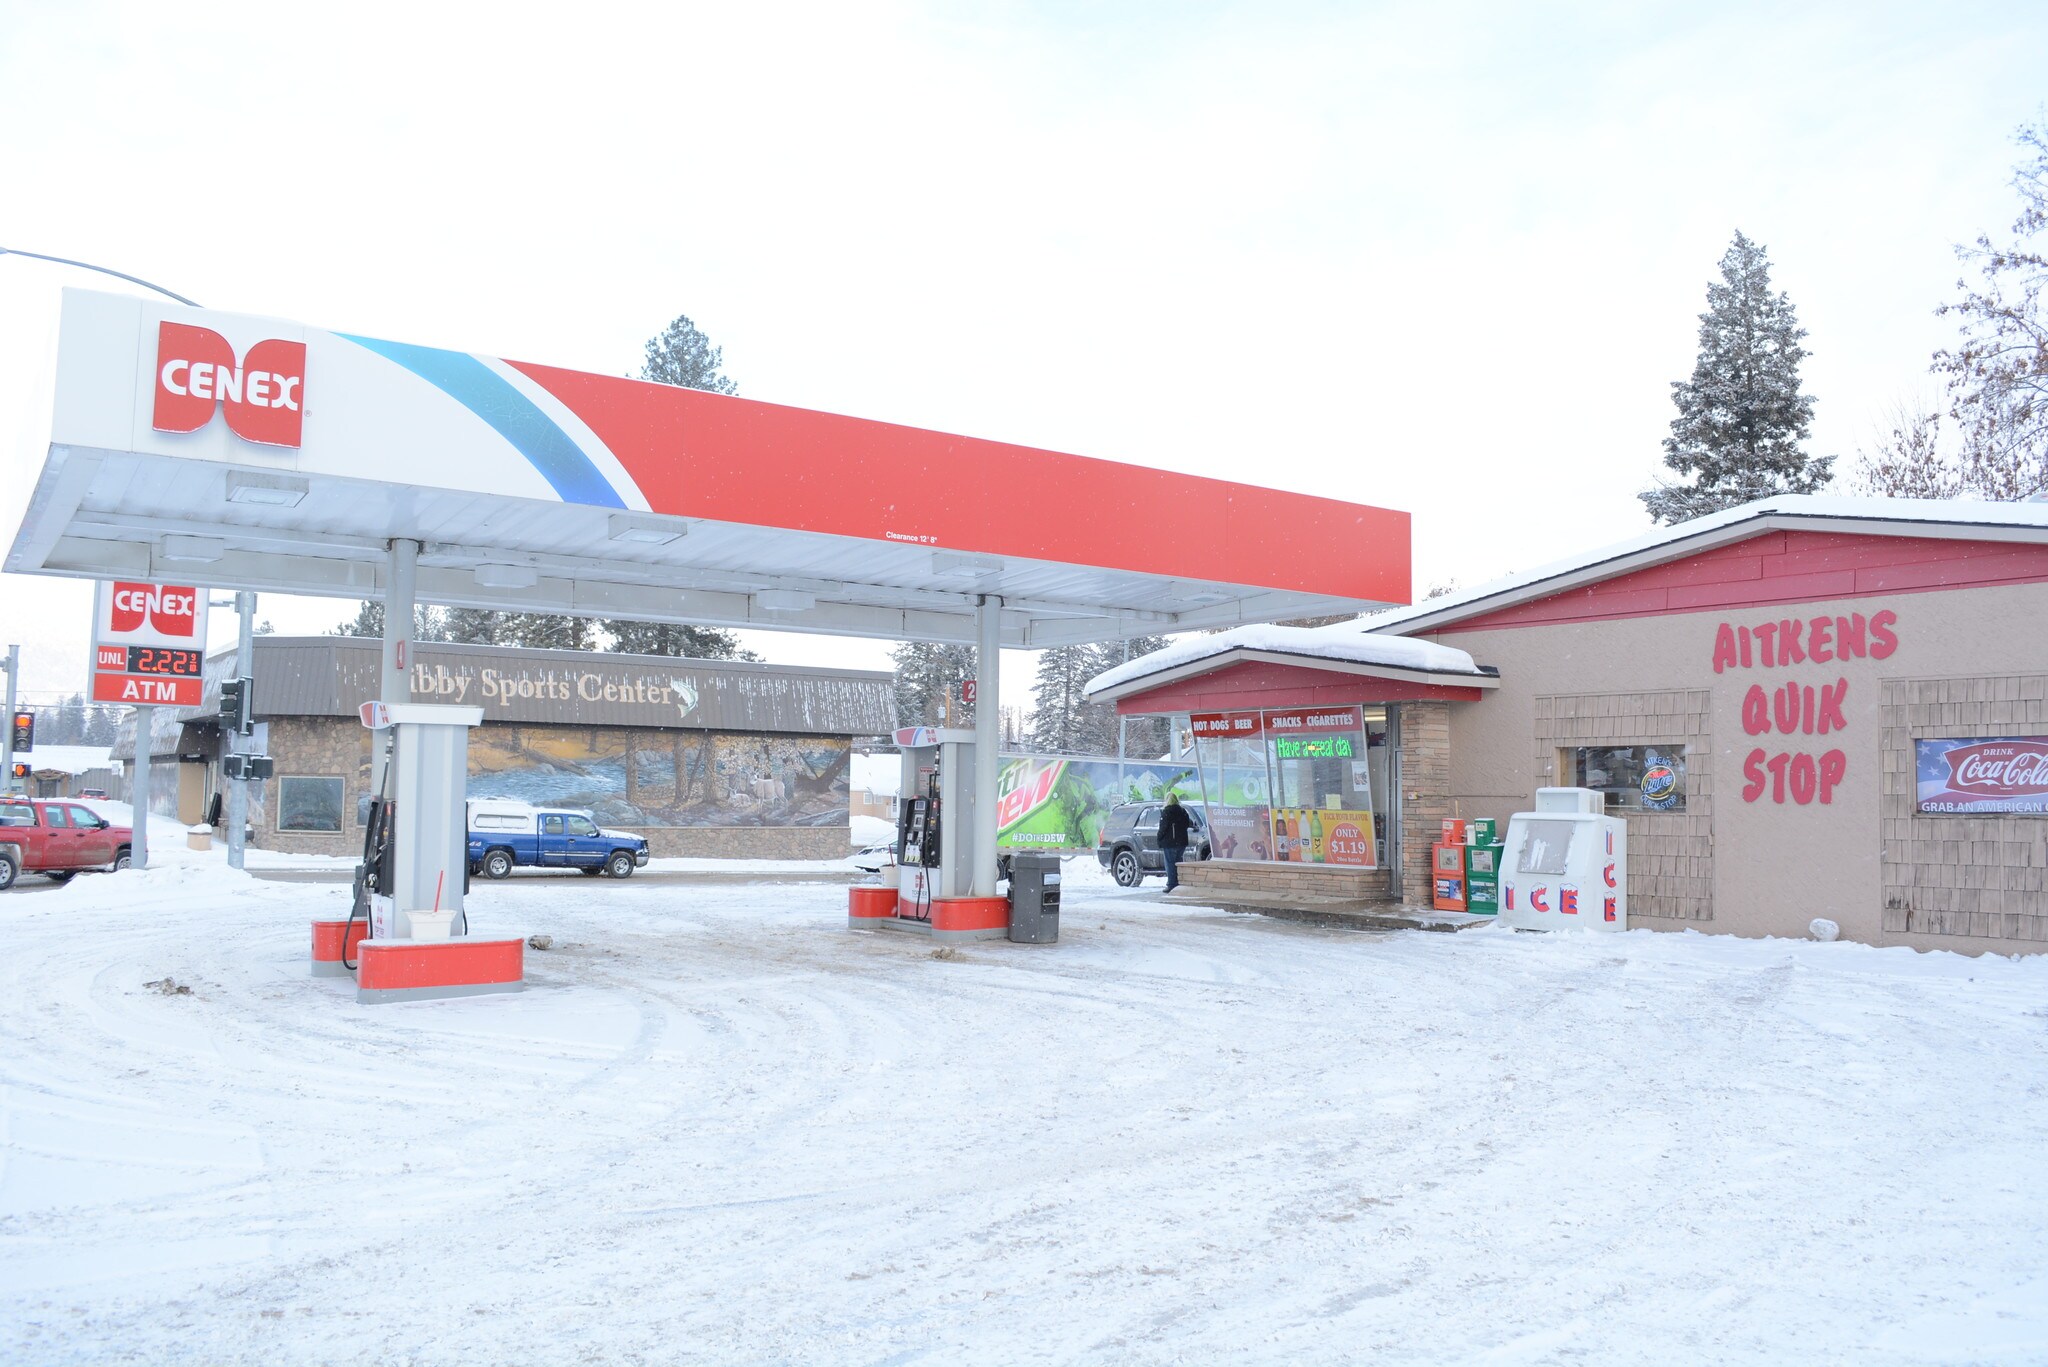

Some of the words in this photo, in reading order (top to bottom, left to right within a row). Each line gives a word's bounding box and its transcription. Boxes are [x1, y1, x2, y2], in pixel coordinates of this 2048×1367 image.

[162, 359, 300, 411] CENEX
[886, 531, 918, 542] Clearance
[115, 590, 193, 616] CENEX
[1712, 609, 1898, 673] AITKENS
[98, 651, 125, 665] UNL
[122, 680, 177, 701] ATM
[410, 663, 472, 703] ibby
[481, 668, 571, 706] Sports
[578, 673, 672, 704] Center
[967, 683, 975, 699] 2
[1742, 677, 1848, 736] QUIK
[1193, 721, 1208, 731] HOT
[1210, 719, 1230, 730] DOGS
[1234, 719, 1253, 730] BEER
[1272, 716, 1302, 729] SNACKS
[1306, 713, 1354, 727] CIGARETTES
[1277, 737, 1300, 758] Have
[1983, 748, 2014, 756] DRINK
[1742, 748, 1847, 805] STOP
[1213, 808, 1228, 816] GRAB
[1229, 809, 1247, 817] SOME
[1921, 802, 1954, 813] GRAB
[1957, 802, 1974, 812] AN
[1978, 802, 2042, 812] AMERICAN
[1213, 818, 1255, 828] REFRESHMENT
[1336, 828, 1358, 838] ONLY
[1331, 840, 1366, 855] $1.19
[1505, 881, 1578, 915] ICE
